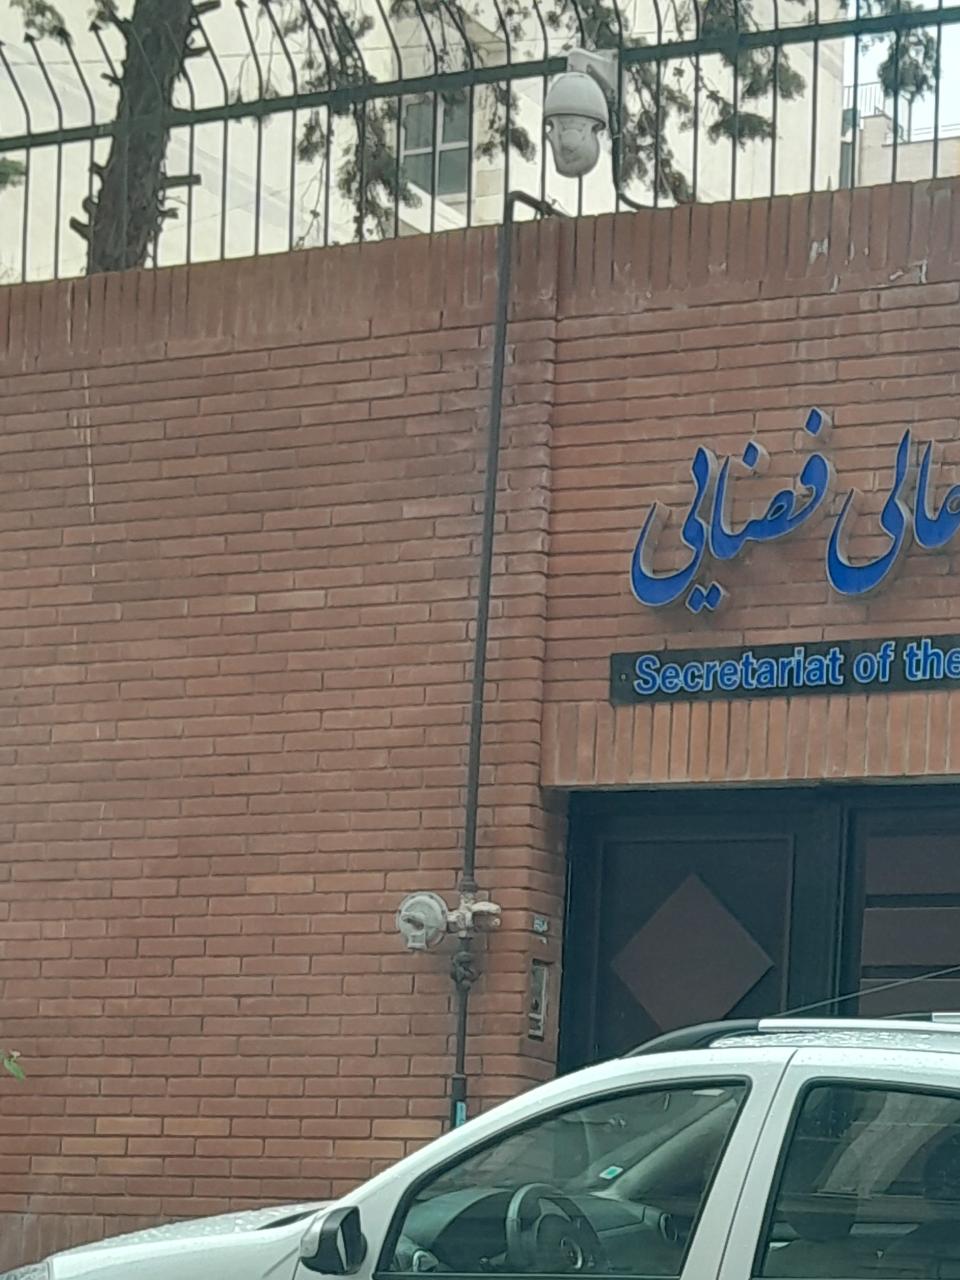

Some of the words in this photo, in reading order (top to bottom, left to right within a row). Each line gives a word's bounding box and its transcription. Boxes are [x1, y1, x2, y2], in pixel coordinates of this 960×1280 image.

[630, 406, 831, 614] فضایی
[633, 647, 844, 695] Secretariat
[852, 639, 896, 686] of
